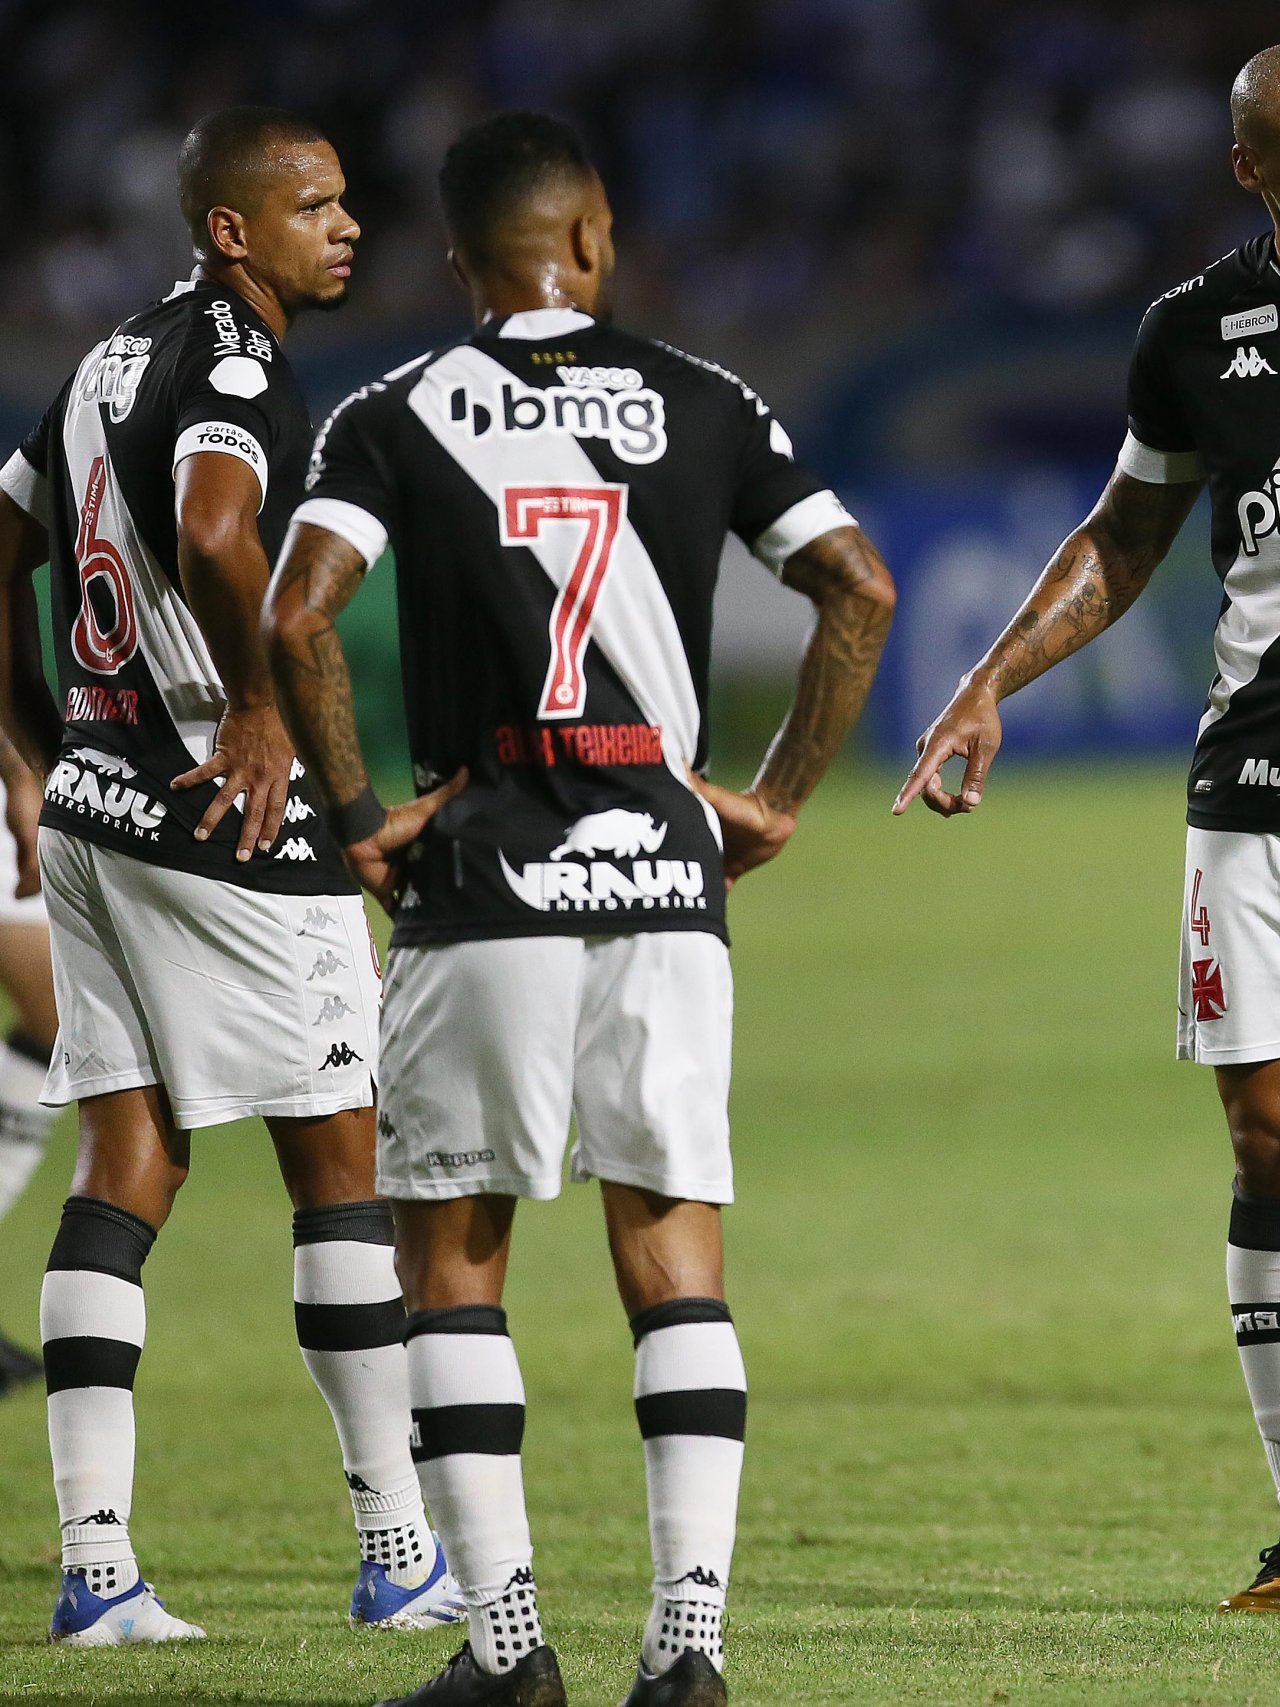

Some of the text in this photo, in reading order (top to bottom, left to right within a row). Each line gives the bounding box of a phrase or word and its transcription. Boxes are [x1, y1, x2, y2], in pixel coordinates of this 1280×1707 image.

[1230, 312, 1275, 331] HEBRON
[556, 365, 644, 391] VASCO
[205, 425, 243, 439] Cartão
[502, 383, 658, 455] bmg
[197, 432, 259, 465] TODOS
[71, 455, 138, 675] 6
[499, 481, 629, 720] 7
[102, 813, 160, 842] DRINK
[642, 895, 707, 911] DRINK
[1191, 867, 1211, 946] 4
